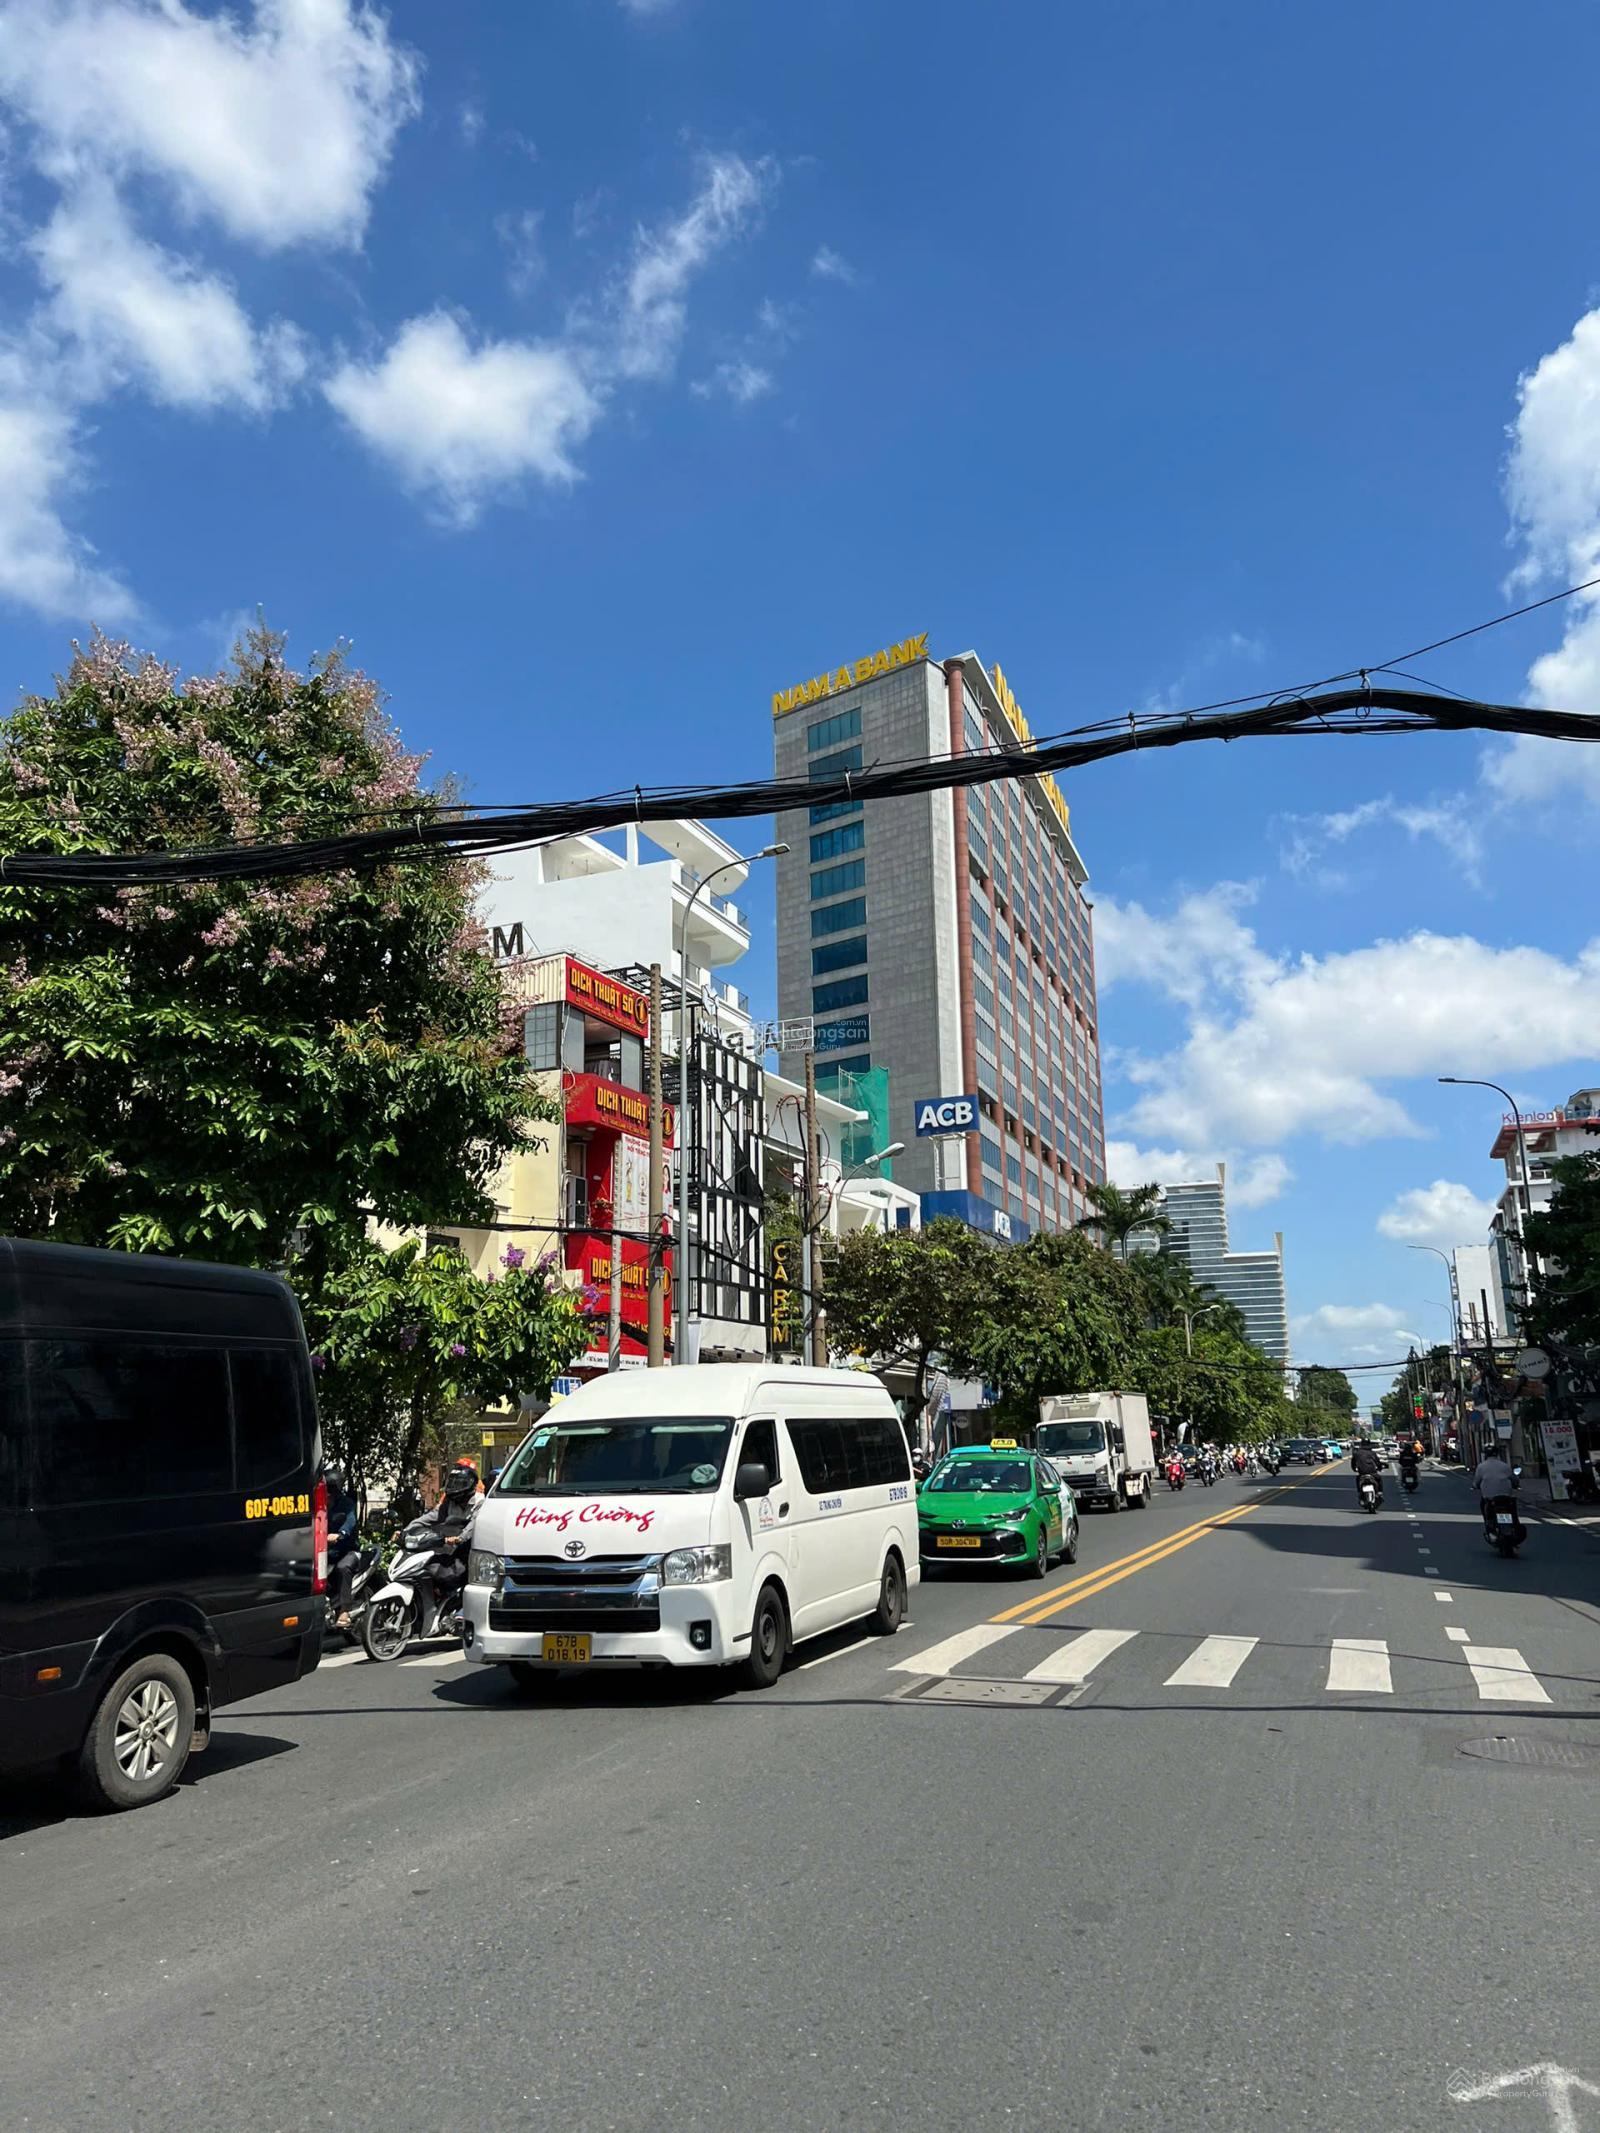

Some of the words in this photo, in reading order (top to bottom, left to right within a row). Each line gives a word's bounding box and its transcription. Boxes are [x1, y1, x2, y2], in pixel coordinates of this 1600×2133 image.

[772, 673, 830, 716] NAM
[834, 665, 851, 691] A
[854, 632, 928, 684] BANK
[571, 967, 592, 993] DỊCH
[594, 979, 621, 1009] THUẬT
[622, 992, 635, 1015] SỐ
[597, 1086, 618, 1111] DỊCH
[621, 1095, 647, 1123] THUẬT
[918, 1101, 974, 1130] ACB
[622, 1262, 644, 1288] HUẬT
[245, 1494, 310, 1519] 60F-005.81
[515, 1506, 574, 1532] Hùng
[579, 1503, 656, 1533] Cường
[547, 1648, 587, 1661] 018.19
